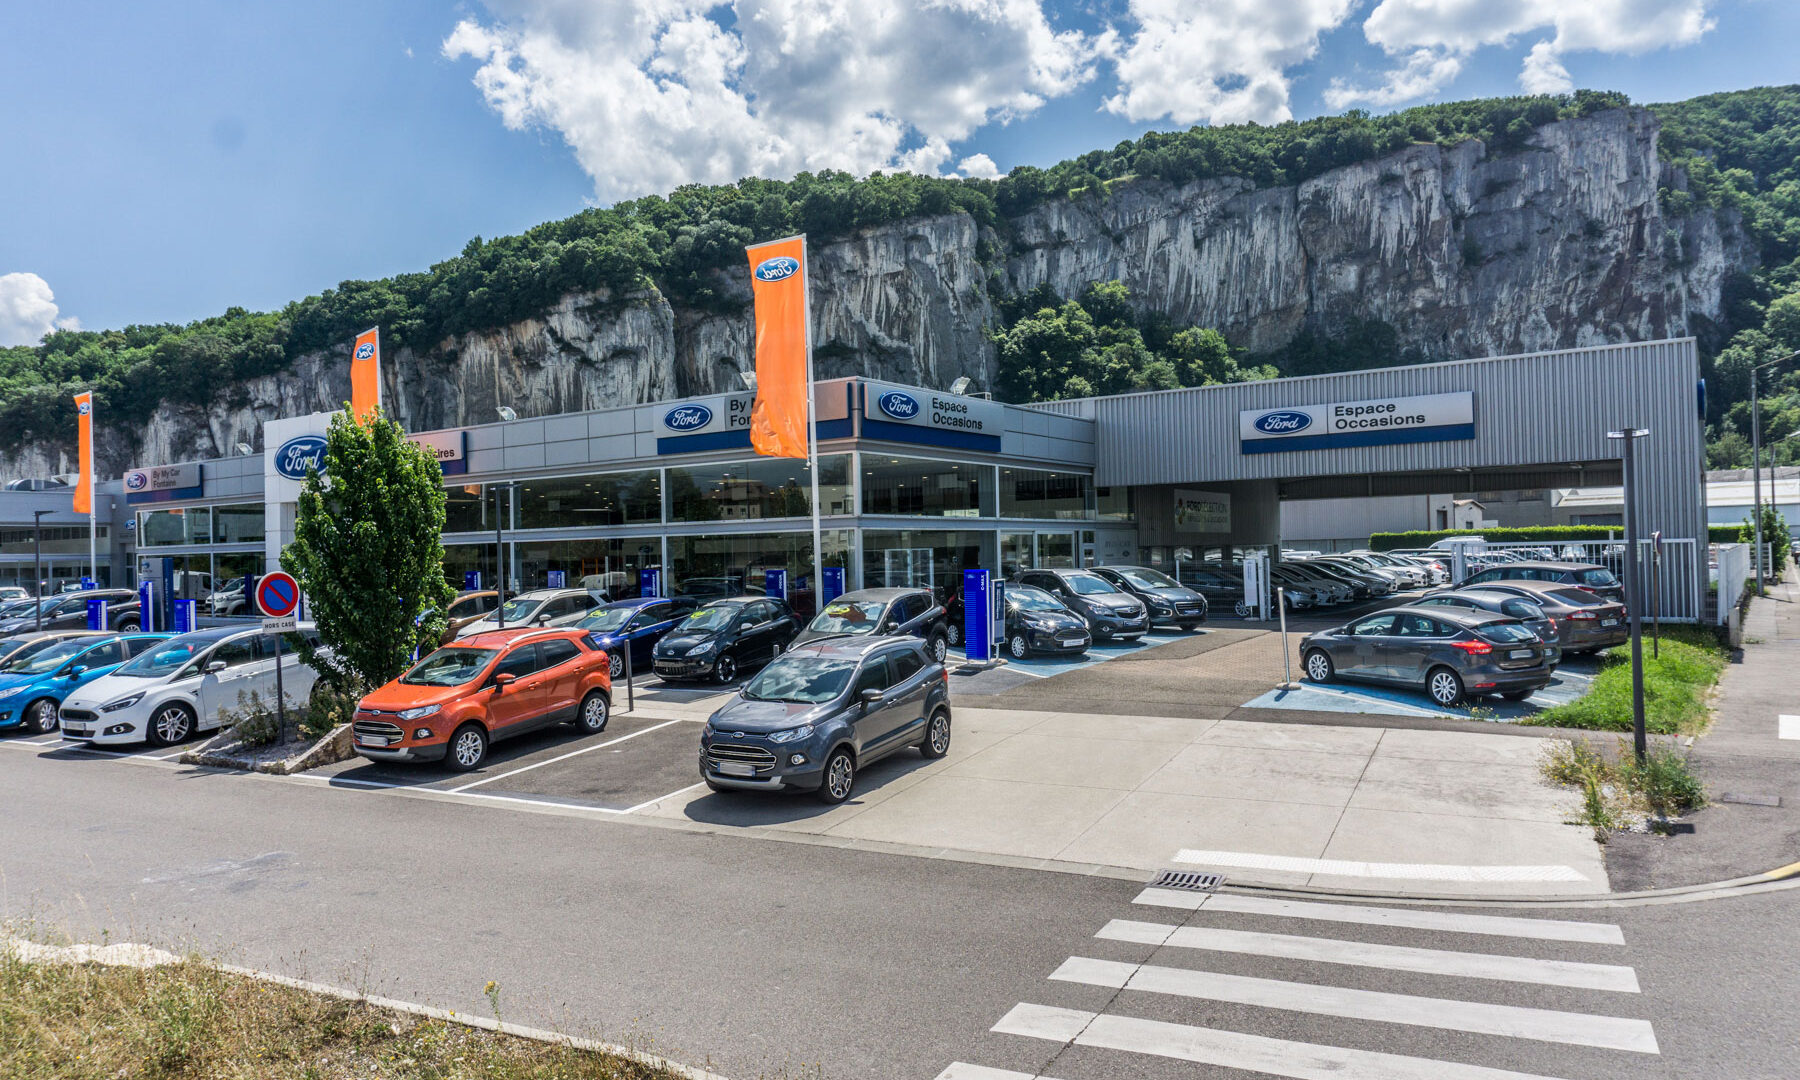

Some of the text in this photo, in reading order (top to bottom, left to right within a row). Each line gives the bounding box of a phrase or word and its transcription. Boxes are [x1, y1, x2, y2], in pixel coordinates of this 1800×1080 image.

[730, 399, 746, 414] By
[888, 395, 913, 415] Ford
[932, 397, 968, 414] Espace
[1334, 403, 1396, 419] Espace
[671, 409, 701, 427] Ford
[932, 412, 983, 430] Occasions
[1264, 414, 1299, 431] Ford
[1335, 413, 1426, 430] Occasions
[285, 444, 321, 472] Ford
